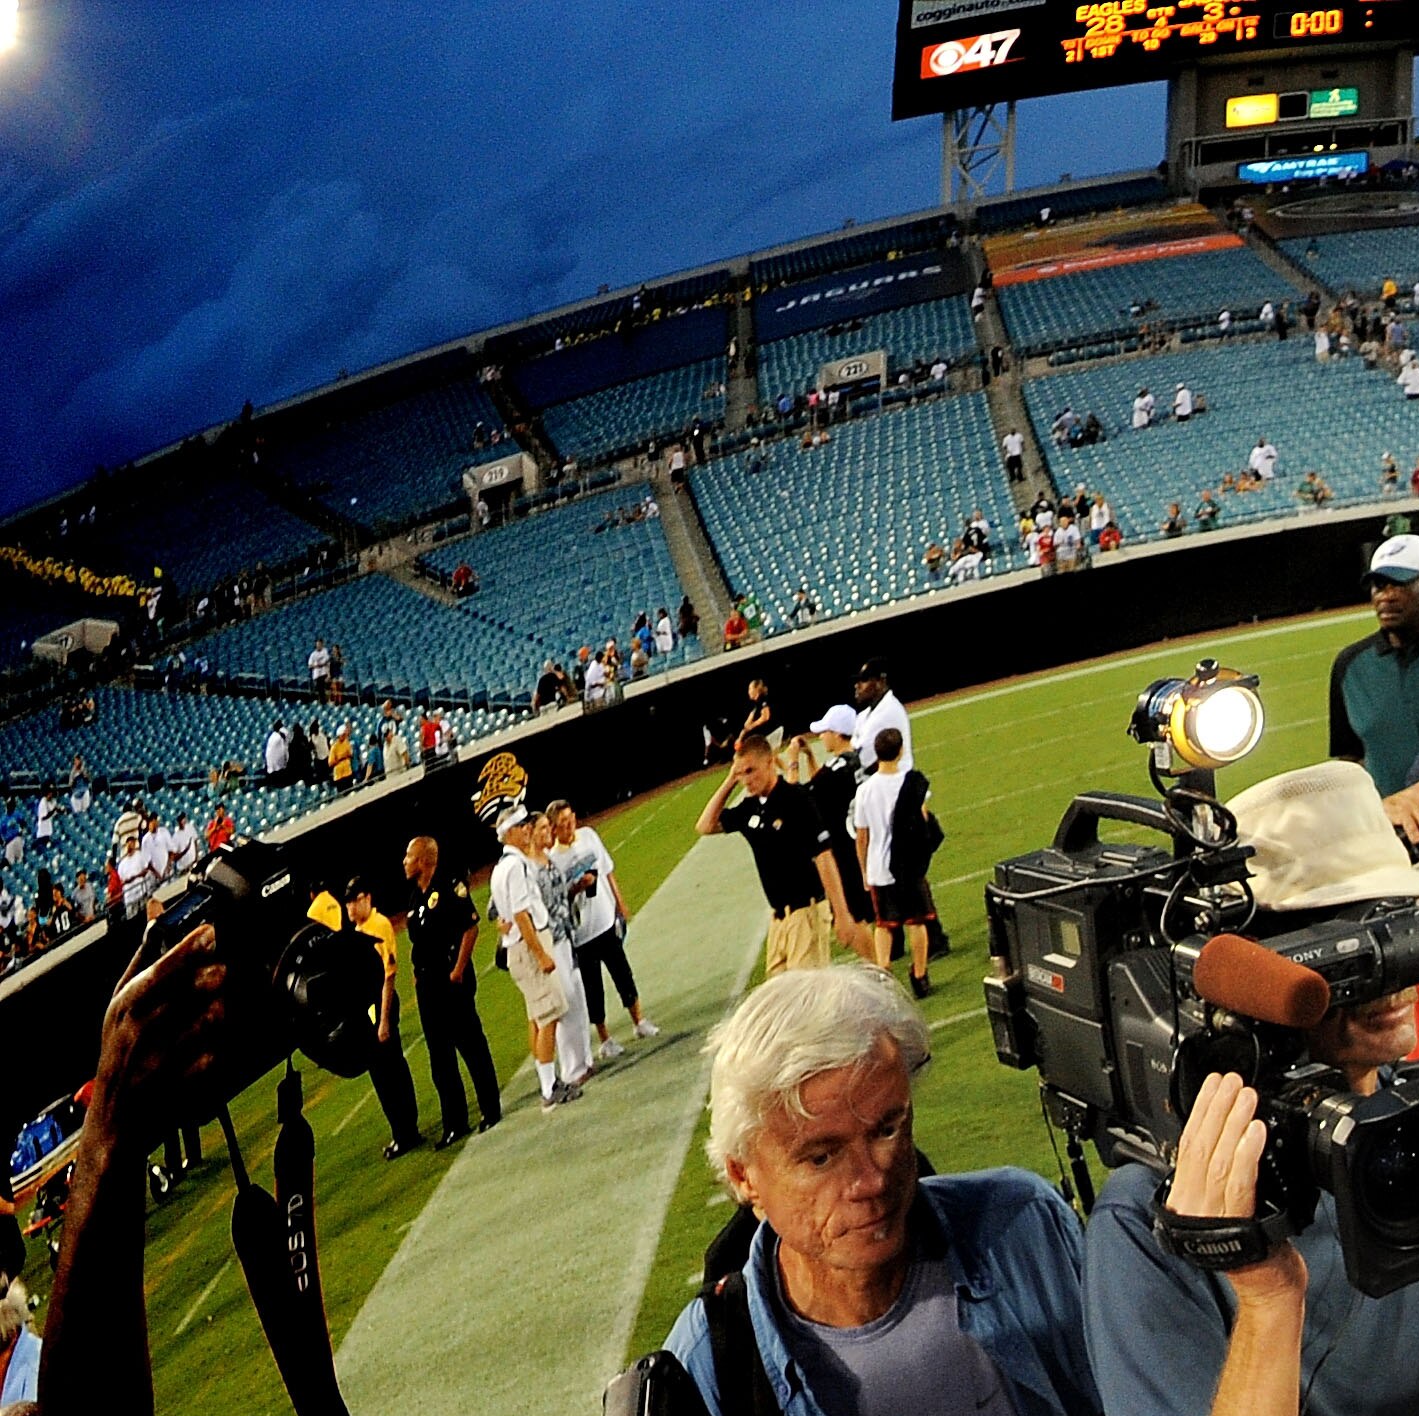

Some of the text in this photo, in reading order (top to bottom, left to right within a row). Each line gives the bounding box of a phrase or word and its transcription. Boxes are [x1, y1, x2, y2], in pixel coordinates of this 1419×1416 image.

[1076, 0, 1146, 22] EAGLES
[1085, 15, 1126, 37] 28
[971, 29, 1022, 66] 47
[261, 873, 291, 898] Canon
[1282, 948, 1323, 964] ONY
[1184, 1236, 1244, 1258] Canon
